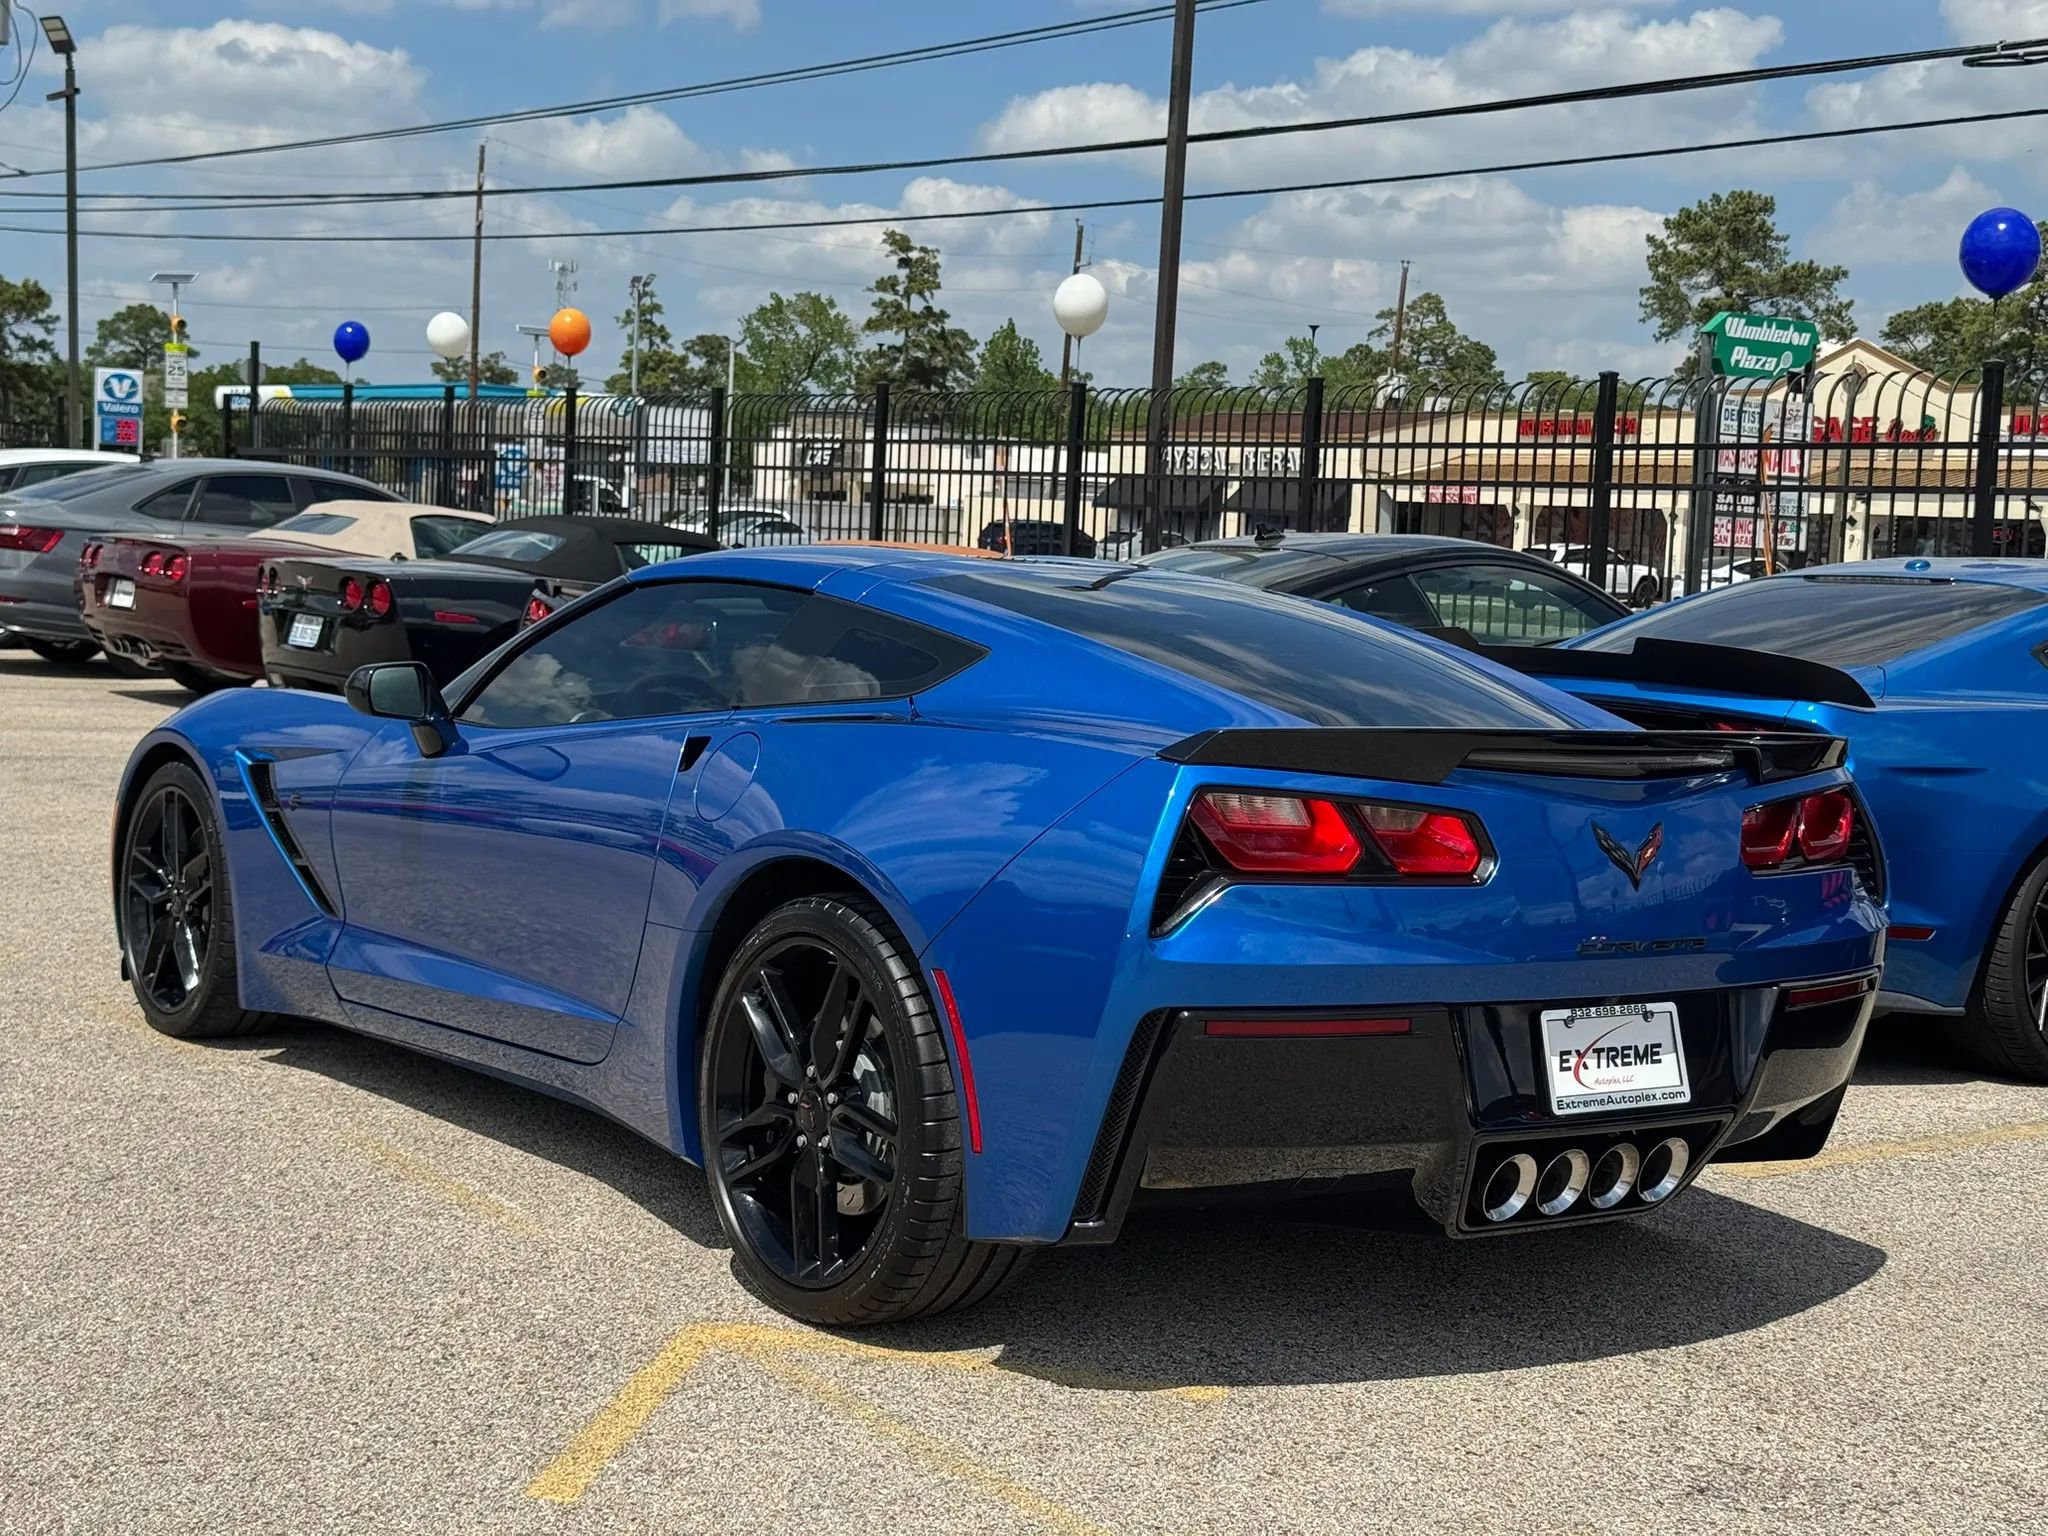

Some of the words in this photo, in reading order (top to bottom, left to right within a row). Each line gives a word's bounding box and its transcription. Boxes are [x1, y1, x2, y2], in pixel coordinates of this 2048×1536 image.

[1725, 317, 1811, 346] Wimbledon
[1730, 346, 1777, 371] Plaza
[168, 366, 185, 376] 25
[102, 403, 139, 413] Valero
[1162, 449, 1229, 471] HYSICAL
[1243, 449, 1305, 474] THERA
[1719, 449, 1758, 469] MASAGE
[1717, 493, 1755, 505] SALON
[1725, 518, 1753, 534] CINIC
[1713, 534, 1728, 544] SAN
[1559, 1043, 1663, 1072] EXTREME
[1622, 1074, 1634, 1084] LLC
[1556, 1090, 1686, 1111] ExtremeAutoplex.com
